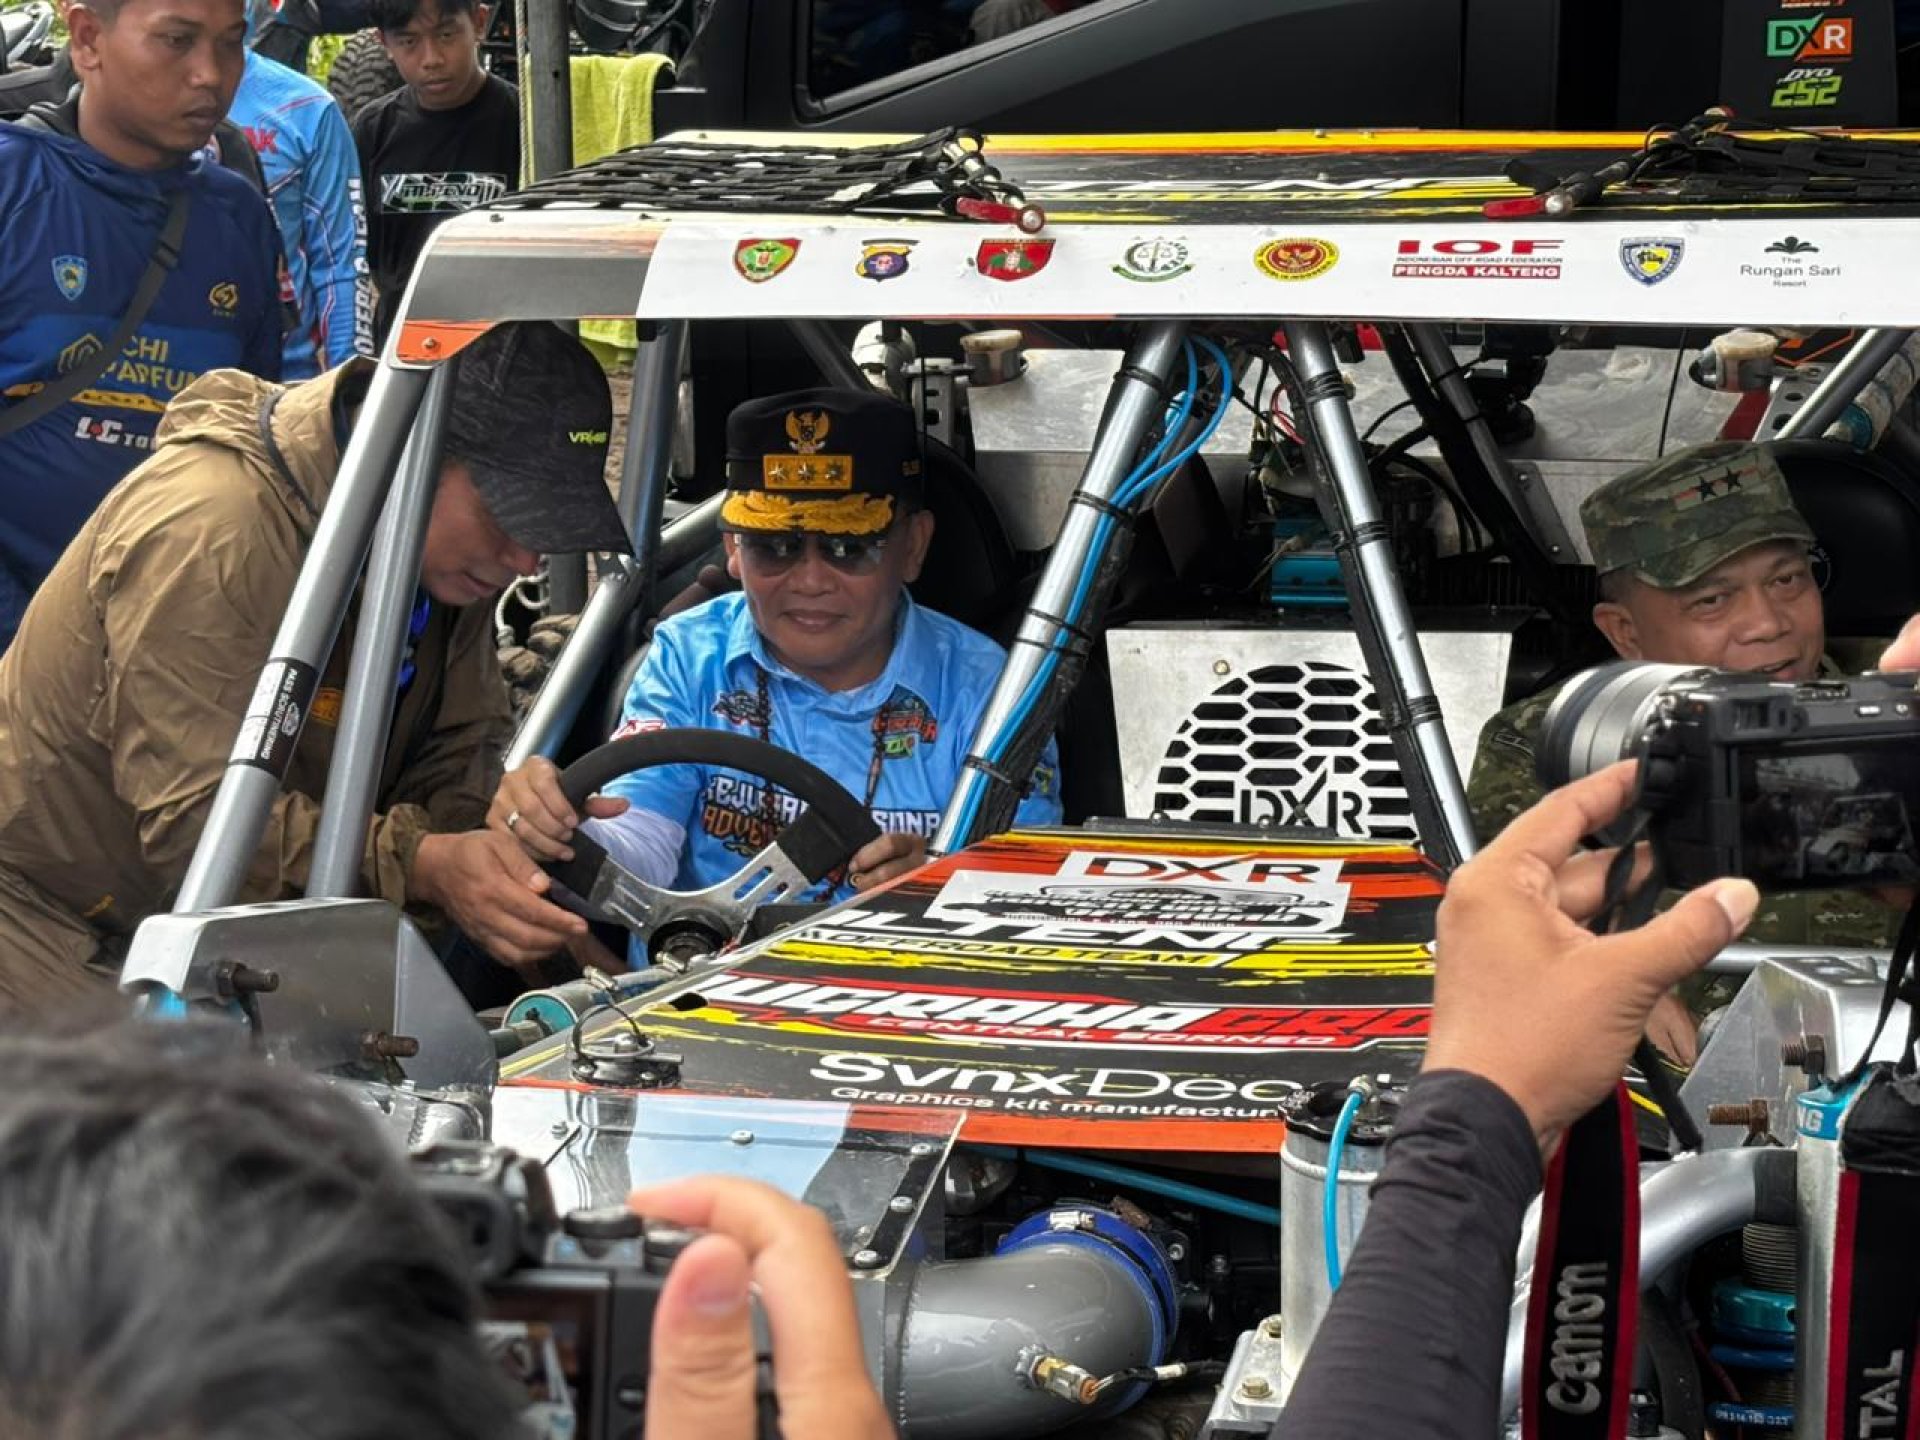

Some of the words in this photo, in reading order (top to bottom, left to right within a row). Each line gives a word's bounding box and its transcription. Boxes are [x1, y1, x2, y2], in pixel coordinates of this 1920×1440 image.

[1773, 20, 1848, 54] DXR
[1397, 240, 1565, 255] IOF
[1394, 266, 1468, 277] PENGDA
[1472, 267, 1558, 278] KALTENG
[1740, 264, 1804, 278] Rungan
[1808, 264, 1841, 276] Sari
[1084, 853, 1321, 882] DXR
[827, 933, 1061, 957] OFFROAD
[1066, 949, 1208, 964] TEAM
[866, 1016, 1095, 1040] CENTRAL
[1112, 1033, 1336, 1045] BORNEO
[831, 1087, 994, 1108] Graphics
[1004, 1097, 1051, 1111] kit
[1546, 1262, 1608, 1414] Canon
[1858, 1349, 1905, 1440] TAL
